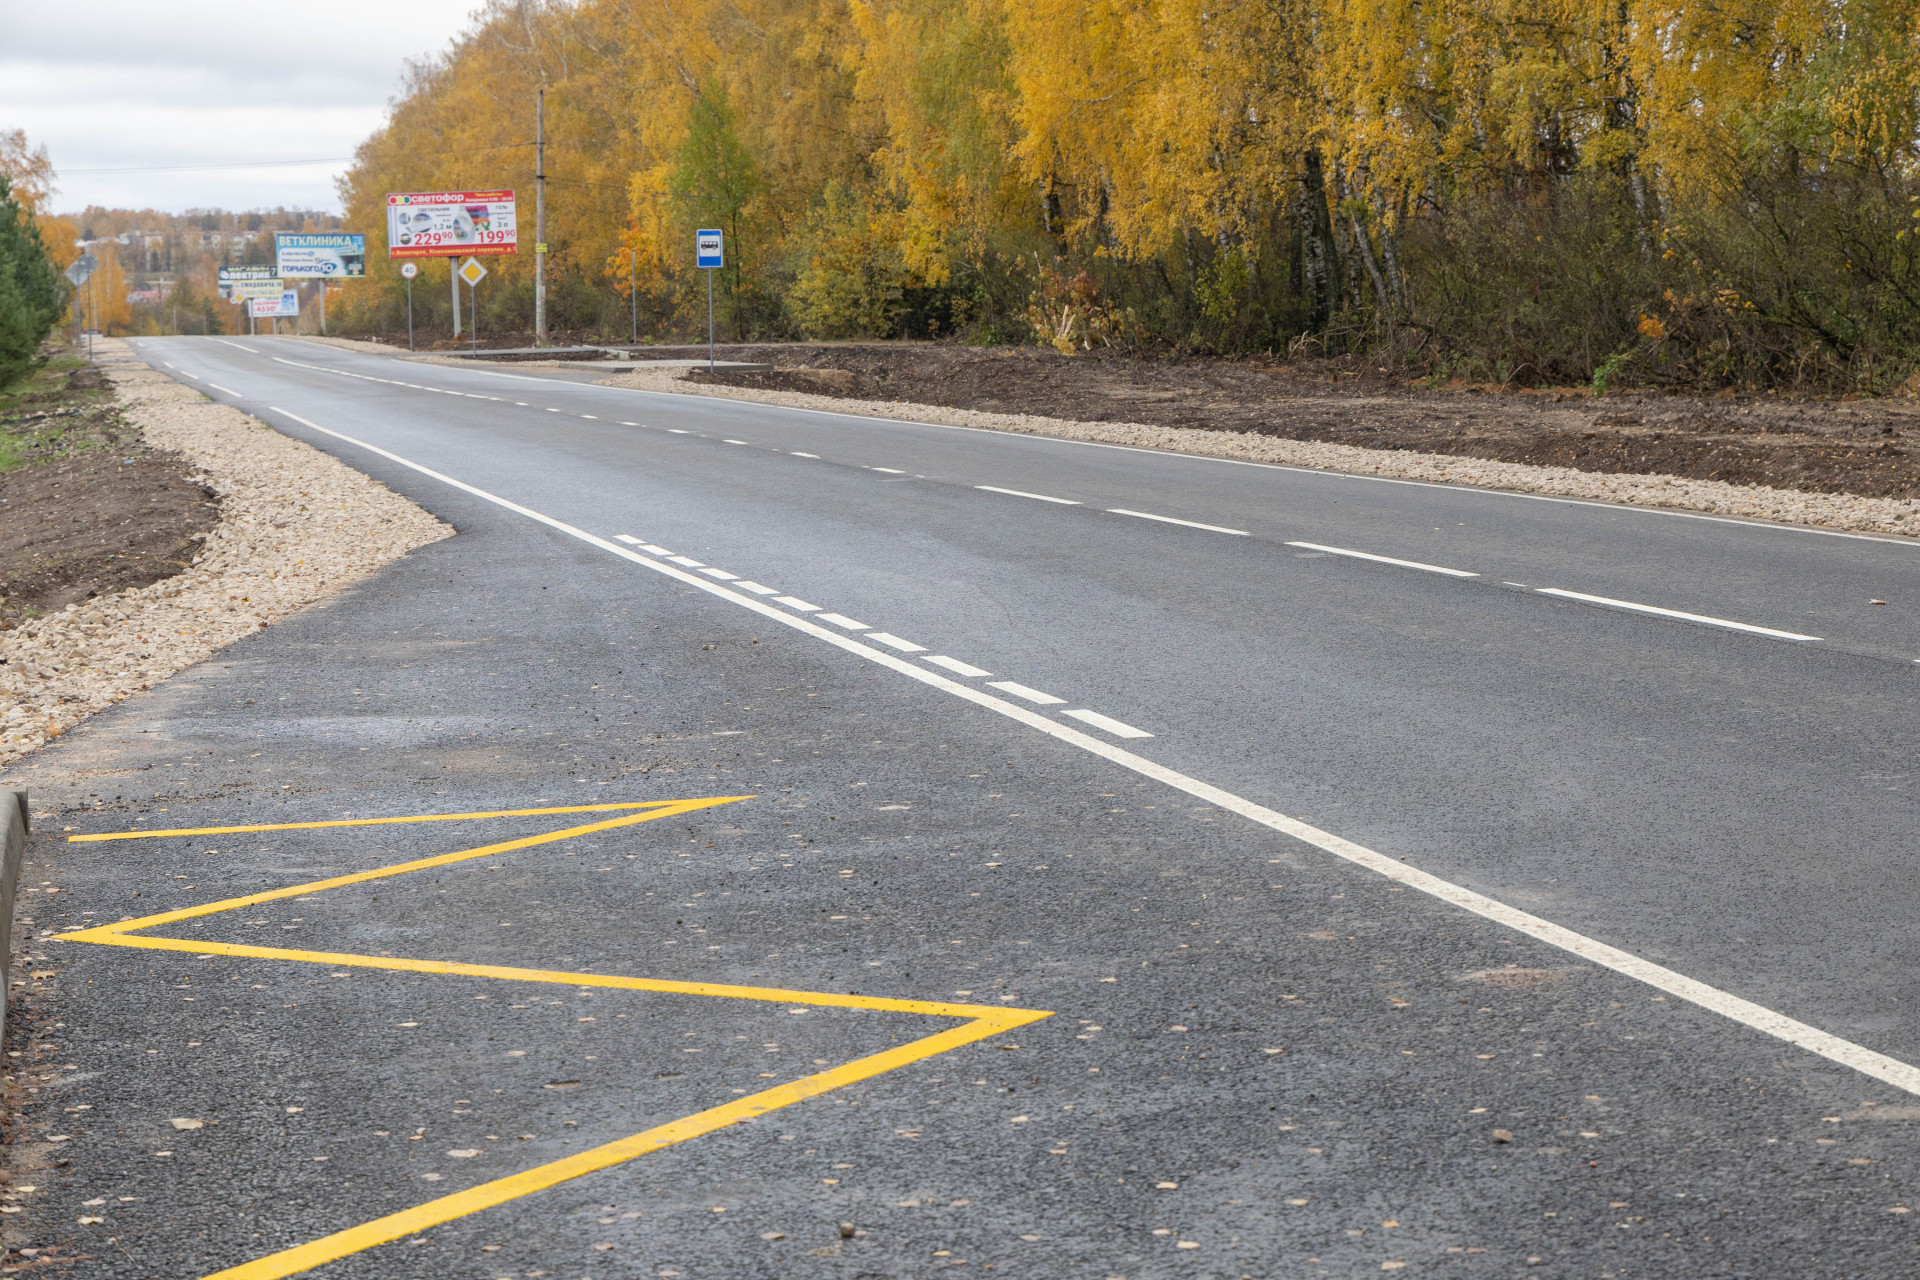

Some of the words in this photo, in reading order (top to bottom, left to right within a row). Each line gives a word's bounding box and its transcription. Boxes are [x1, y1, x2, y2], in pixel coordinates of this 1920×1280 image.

[412, 192, 464, 204] светофор
[279, 236, 352, 246] ВЕТКЛИНИКА
[414, 232, 441, 246] 229
[478, 230, 504, 243] 199
